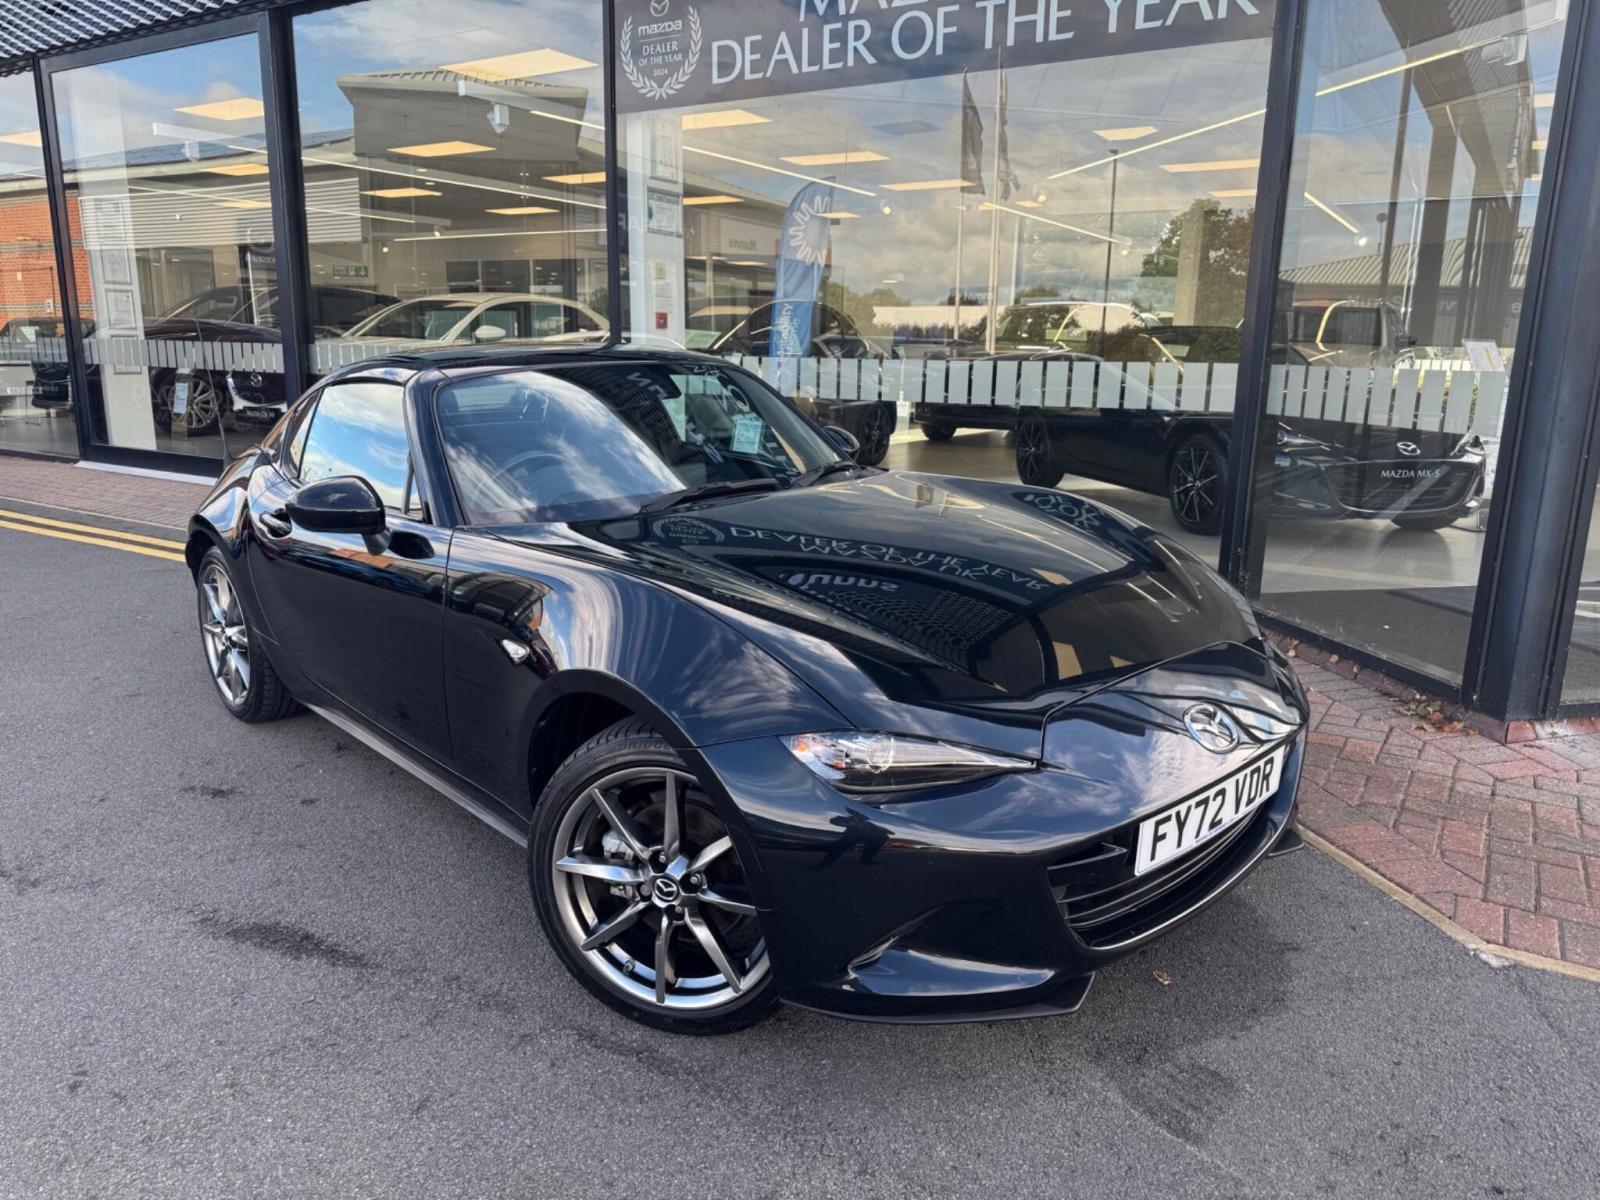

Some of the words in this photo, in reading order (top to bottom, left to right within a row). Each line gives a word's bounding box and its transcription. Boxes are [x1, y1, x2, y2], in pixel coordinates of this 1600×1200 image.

[642, 41, 679, 56] DEALER
[711, 19, 877, 85] DEALER
[891, 4, 960, 60] OF
[975, 0, 1075, 49] THE
[638, 58, 648, 67] OF
[650, 57, 663, 65] THE
[664, 53, 683, 63] YEAR
[1381, 470, 1415, 478] MAZDA
[1417, 469, 1440, 478] MX-5
[1149, 787, 1227, 862] FY72
[1235, 756, 1275, 815] VDR
